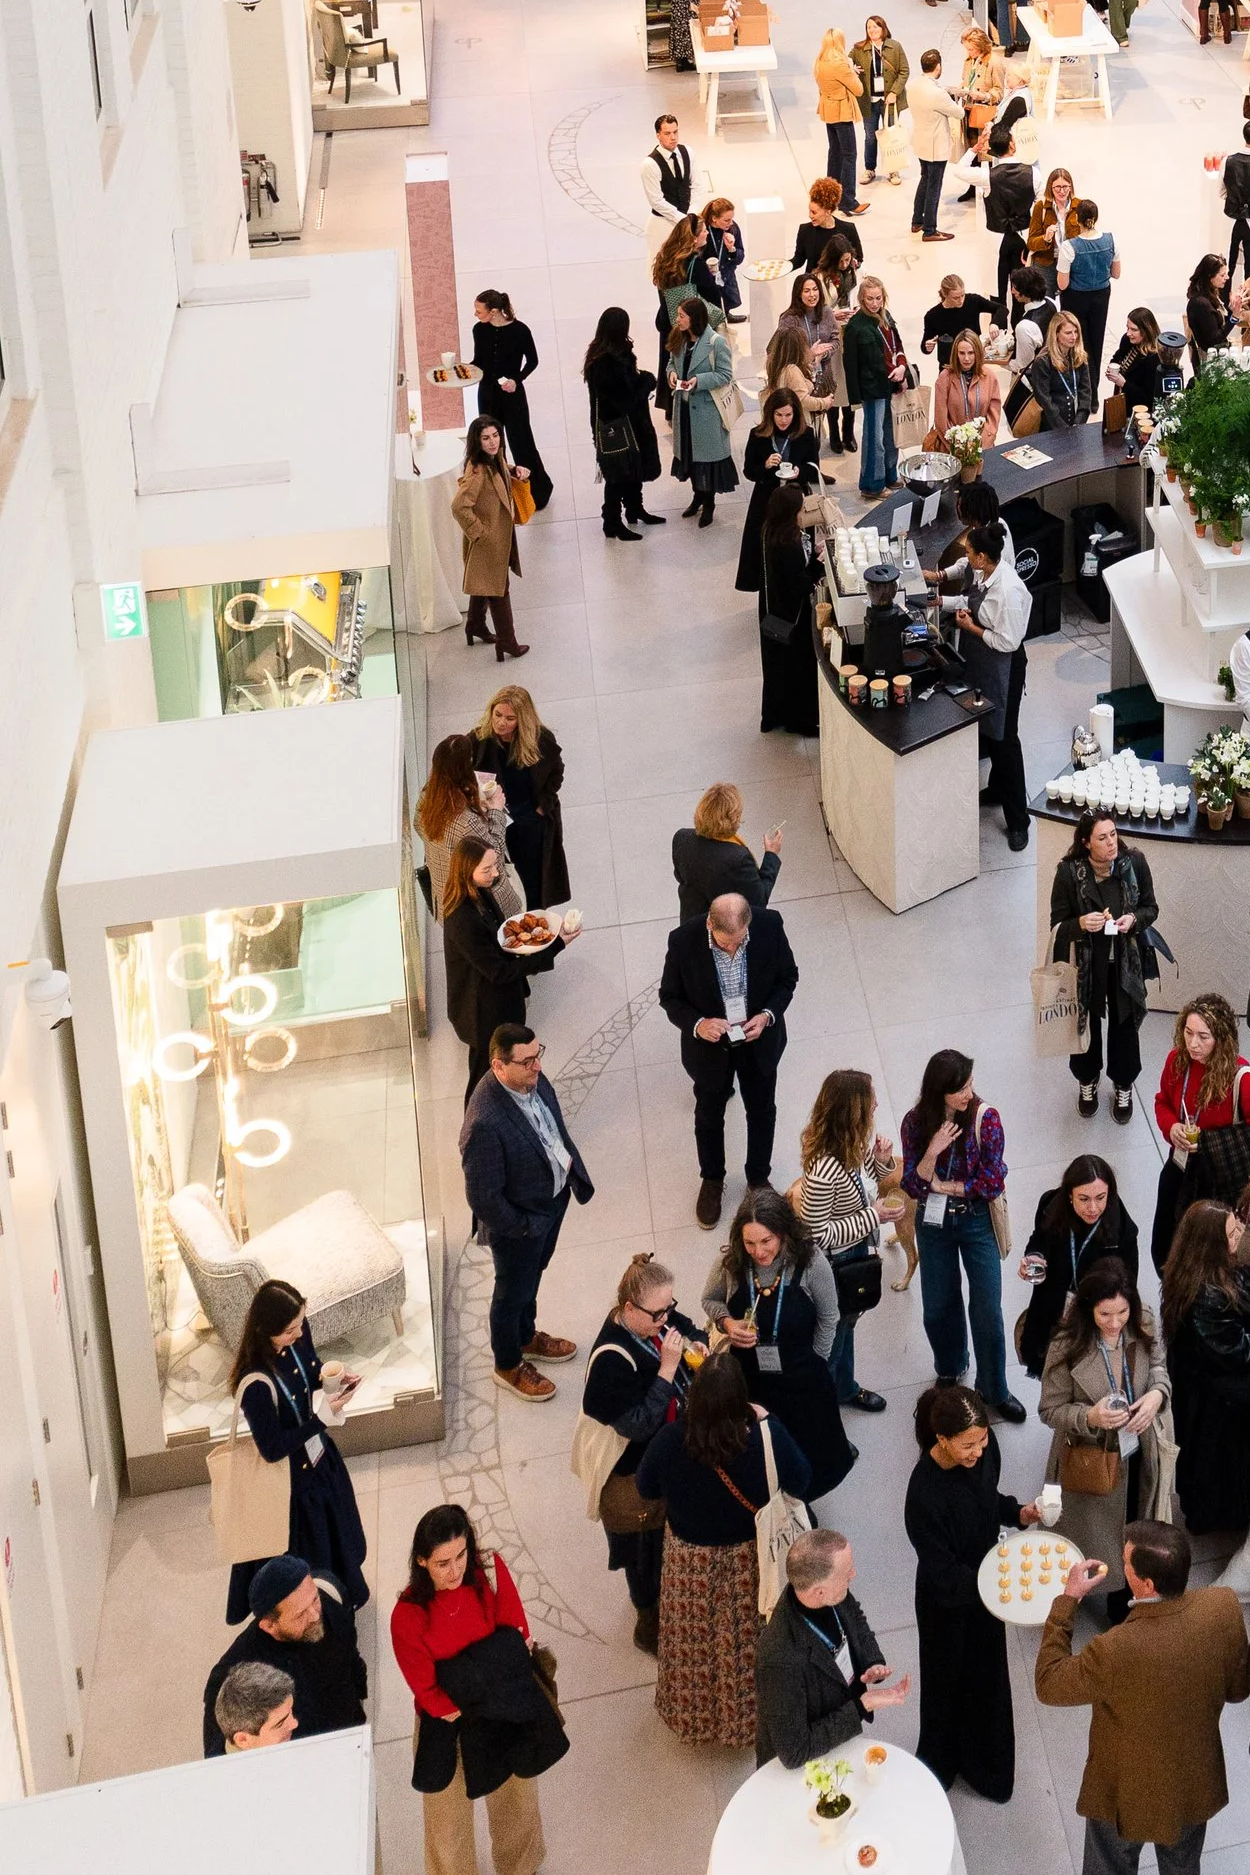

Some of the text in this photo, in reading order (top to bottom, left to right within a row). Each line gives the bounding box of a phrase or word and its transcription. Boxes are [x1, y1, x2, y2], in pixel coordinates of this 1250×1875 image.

[896, 409, 927, 425] LONDON
[1016, 556, 1034, 568] SOCIAL
[1039, 1002, 1077, 1025] LONDO
